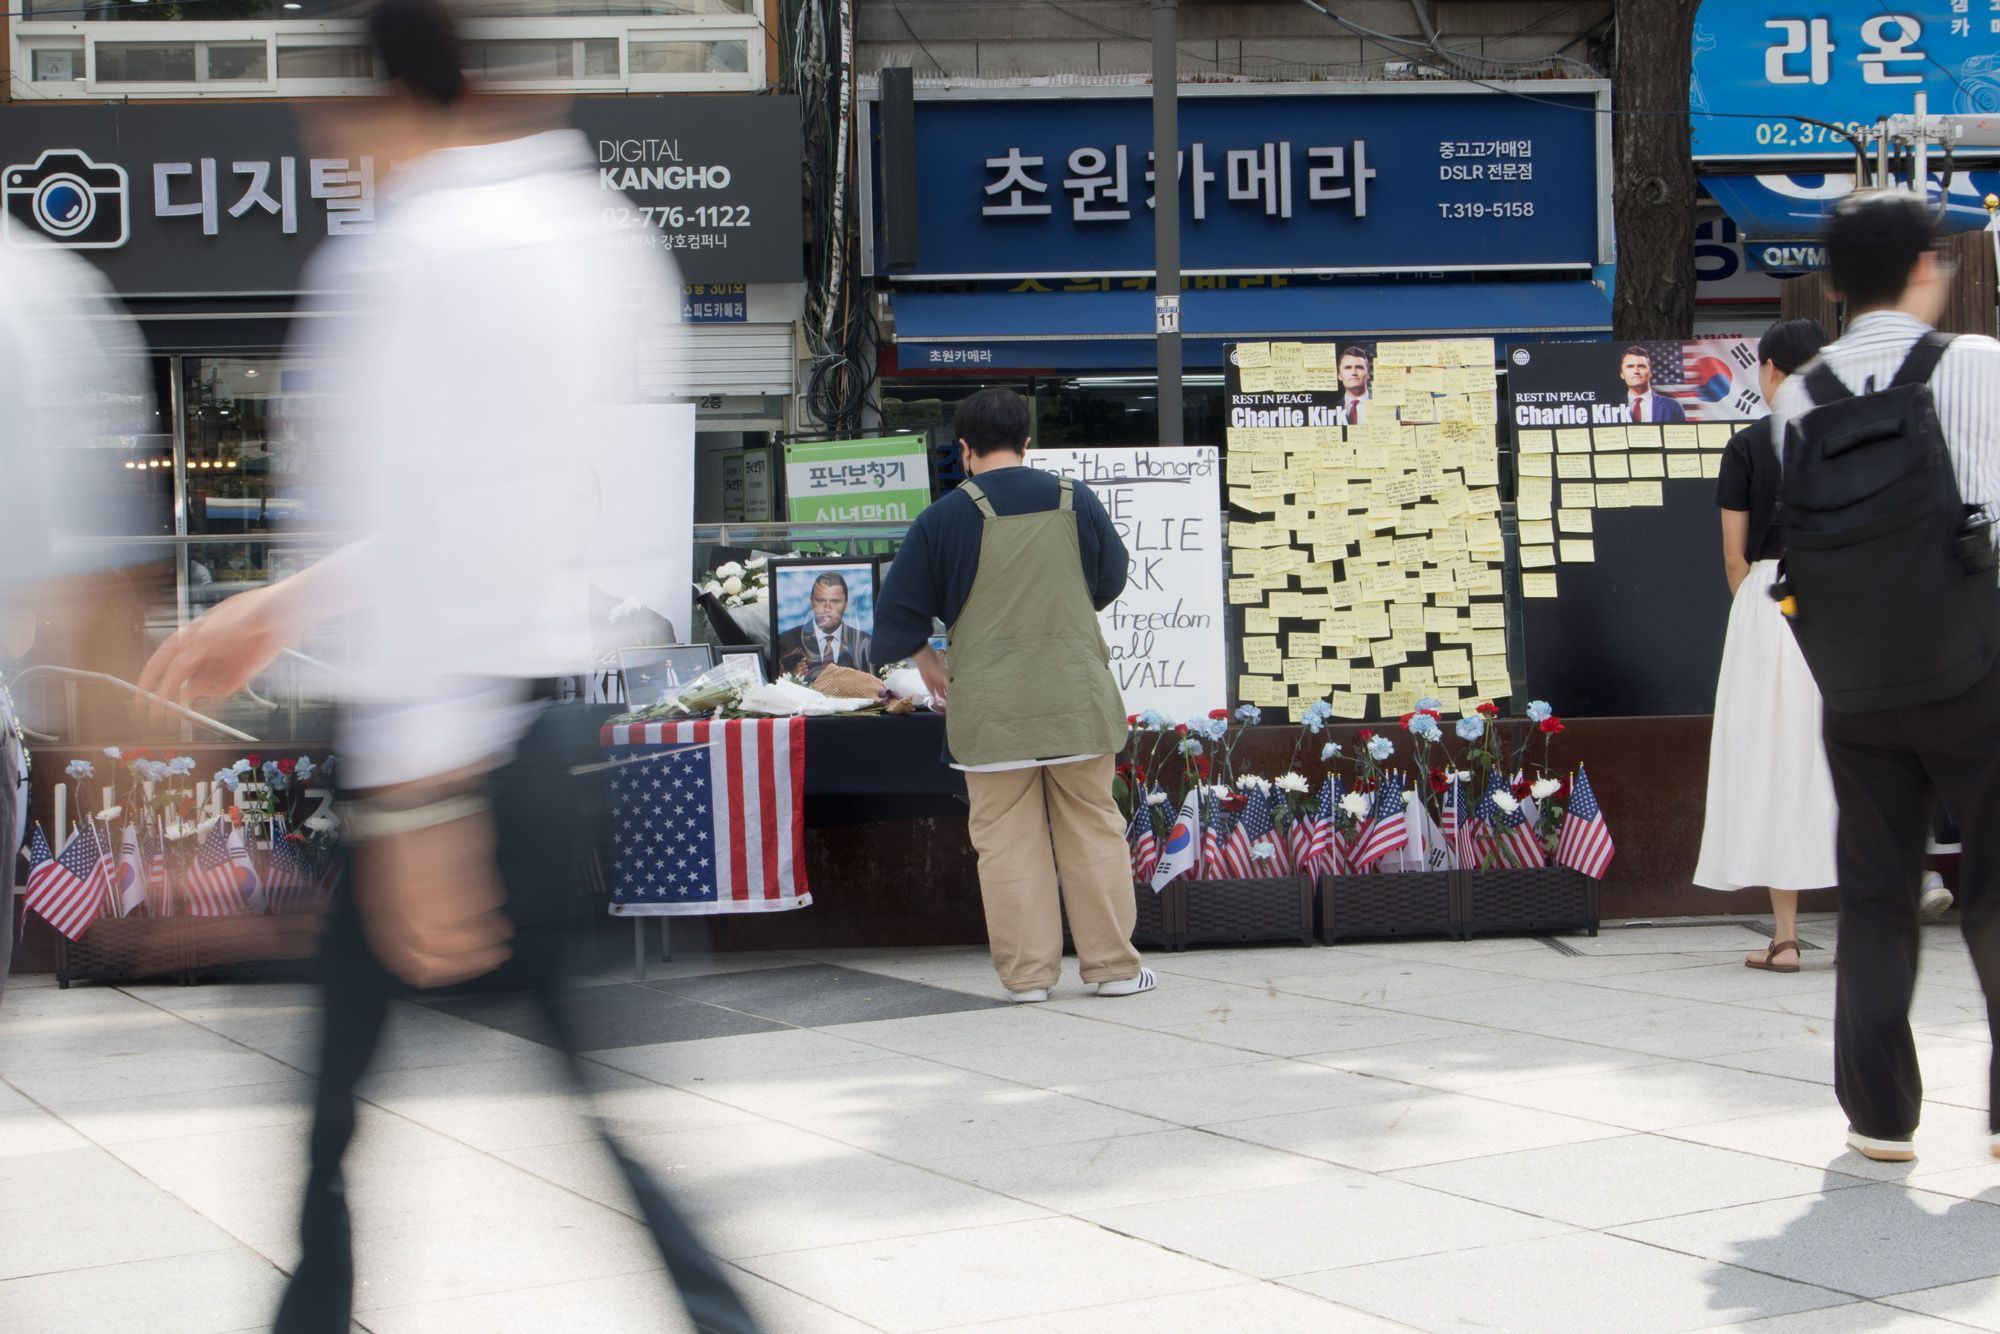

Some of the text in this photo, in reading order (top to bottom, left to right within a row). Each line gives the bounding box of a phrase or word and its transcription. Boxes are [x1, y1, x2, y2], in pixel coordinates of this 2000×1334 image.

[599, 139, 683, 162] DIGITAL
[1440, 140, 1532, 159] 중고고가매입
[600, 165, 731, 190] KANGHO
[1440, 163, 1532, 180] DSLR 전문점
[153, 155, 376, 236] 디지털
[602, 205, 751, 228] 02-776-1122
[1439, 202, 1534, 218] T.319-5158
[660, 234, 727, 250] 강호컴퍼니
[1763, 247, 1830, 266] OLYM
[683, 303, 743, 317] 스피드카메라
[1160, 314, 1173, 327] 11
[929, 350, 992, 363] 초원카메라
[1232, 394, 1313, 404] REST IN PEACE
[1515, 392, 1597, 402] REST IN PEACE
[1231, 405, 1349, 427] Charlie Kirk
[1515, 403, 1634, 425] Charlie Kirk
[809, 461, 906, 489] 포낙보청기
[1095, 488, 1134, 519] HE
[1107, 598, 1210, 630] freedom
[1108, 631, 1155, 660] all
[1119, 660, 1195, 690] VAIL
